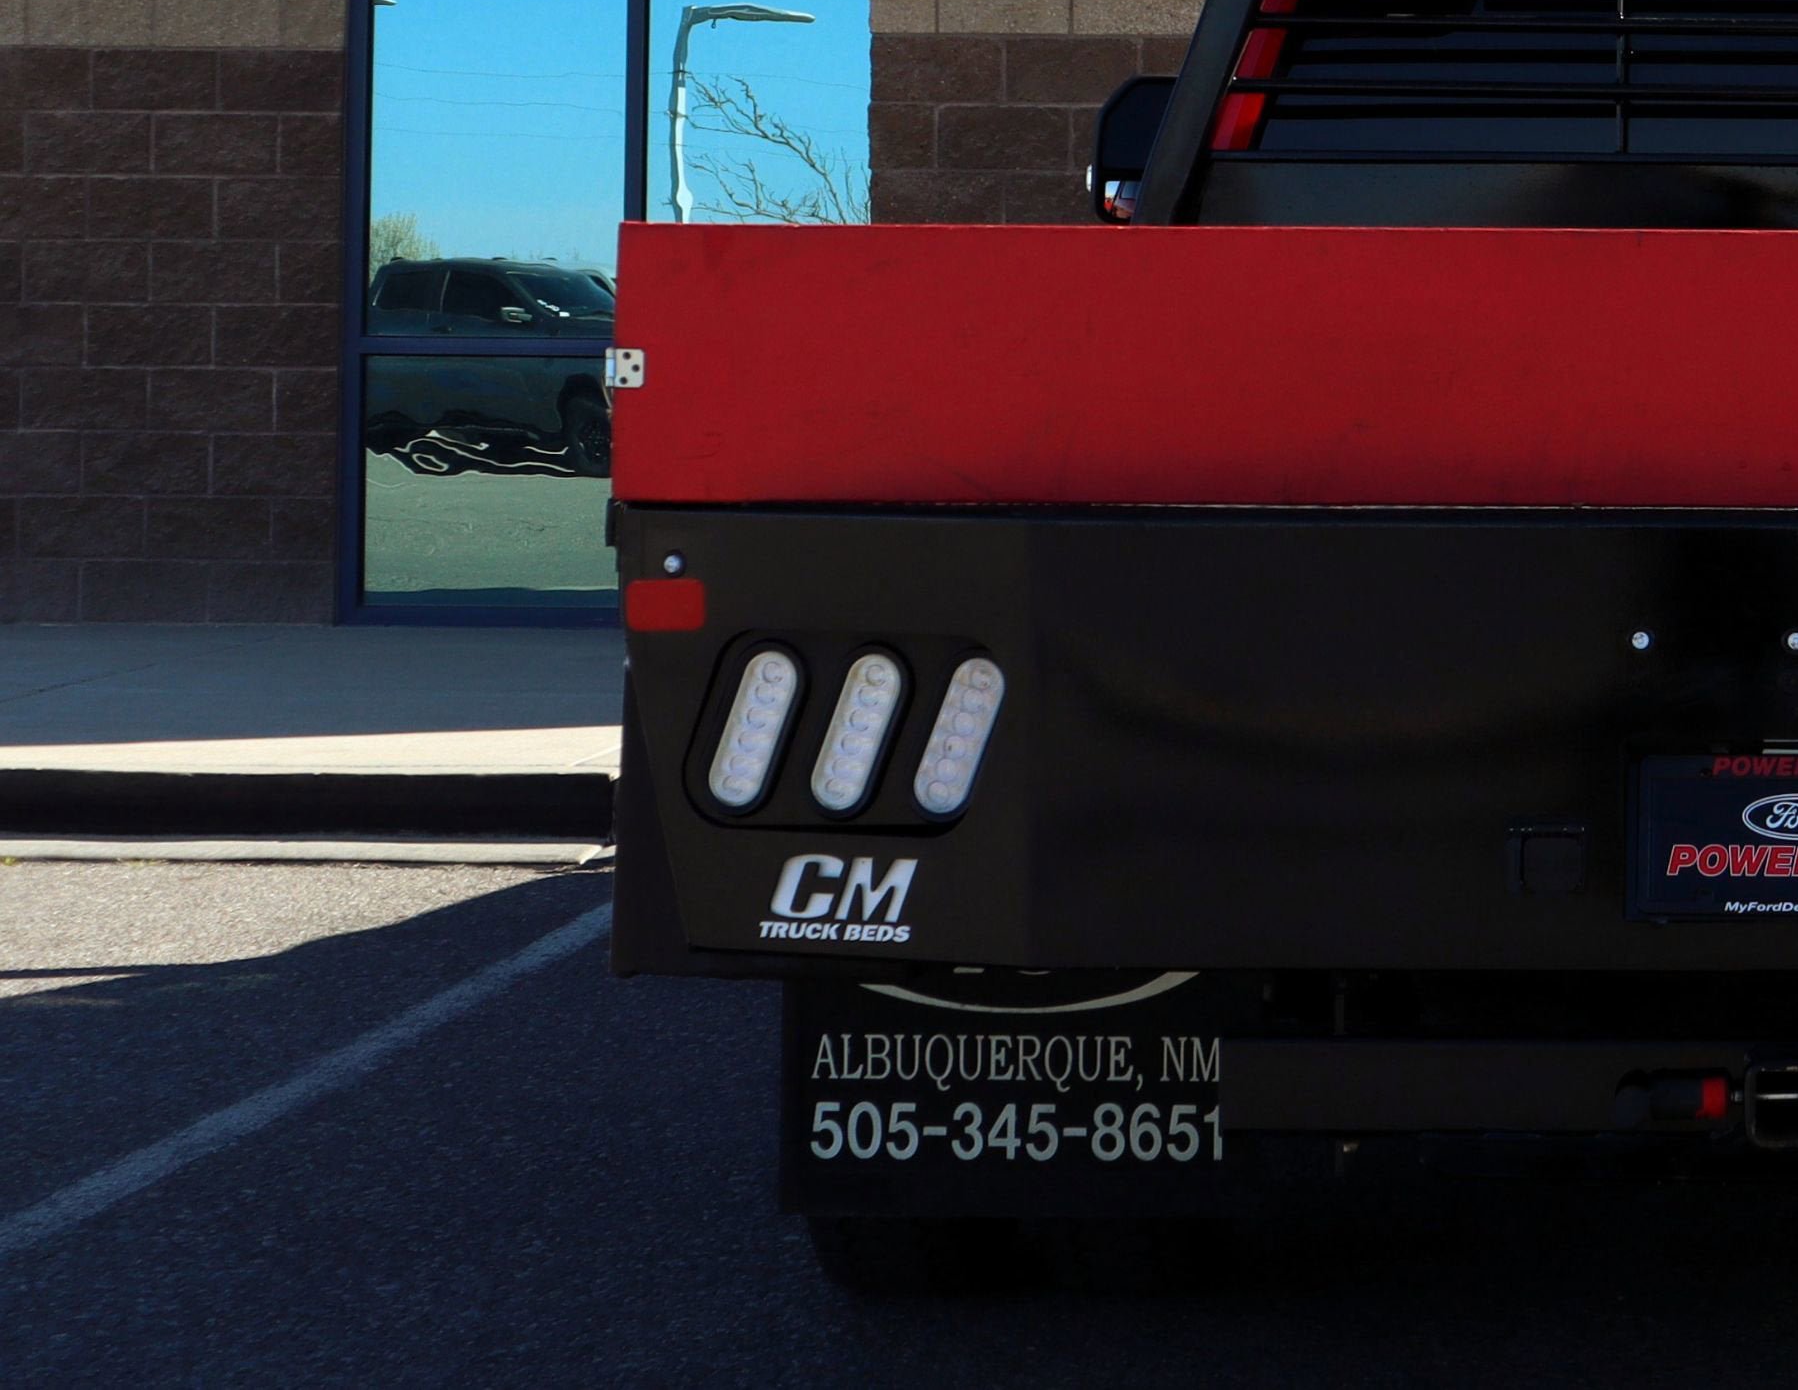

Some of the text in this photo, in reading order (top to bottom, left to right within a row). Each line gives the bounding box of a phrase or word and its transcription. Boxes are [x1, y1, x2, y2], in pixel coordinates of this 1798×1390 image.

[769, 852, 919, 924] CM
[758, 921, 911, 943] TRUCK BEDS
[811, 1033, 1221, 1092] ALBUQUERQUE, NM
[810, 1100, 1223, 1162] 505-345-8651
